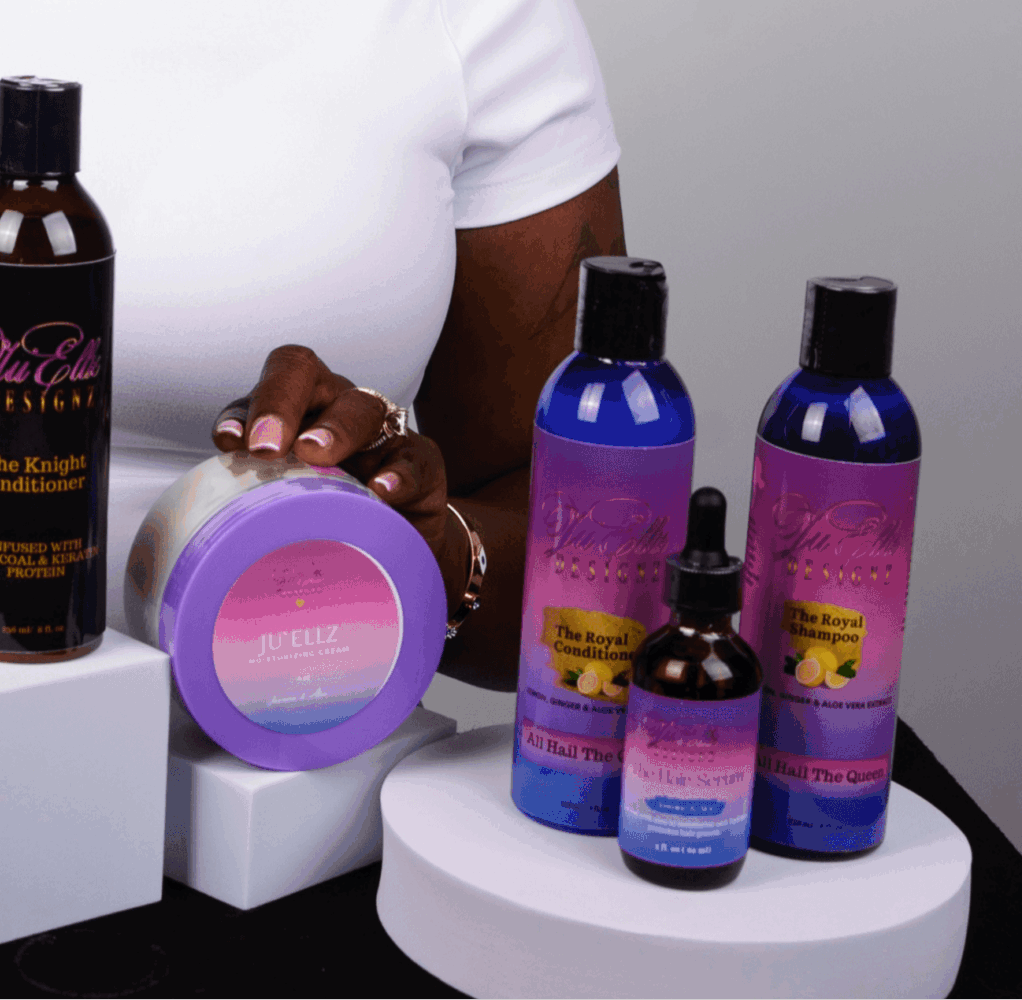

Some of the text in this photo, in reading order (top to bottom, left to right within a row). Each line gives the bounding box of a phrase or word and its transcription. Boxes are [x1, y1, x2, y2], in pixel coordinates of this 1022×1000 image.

[24, 454, 87, 477] Knight
[51, 538, 83, 552] WITH
[6, 565, 66, 579] PROTEIN
[37, 555, 48, 566] &
[555, 554, 660, 584] DESIGNZ
[790, 607, 863, 631] The Royal
[555, 625, 629, 650] The Royal
[789, 623, 859, 646] Shampoo
[526, 732, 544, 750] All
[546, 739, 578, 759] Hail
[581, 747, 614, 763] The
[775, 758, 809, 780] Hail
[812, 767, 844, 784] The
[846, 768, 885, 784] Queen
